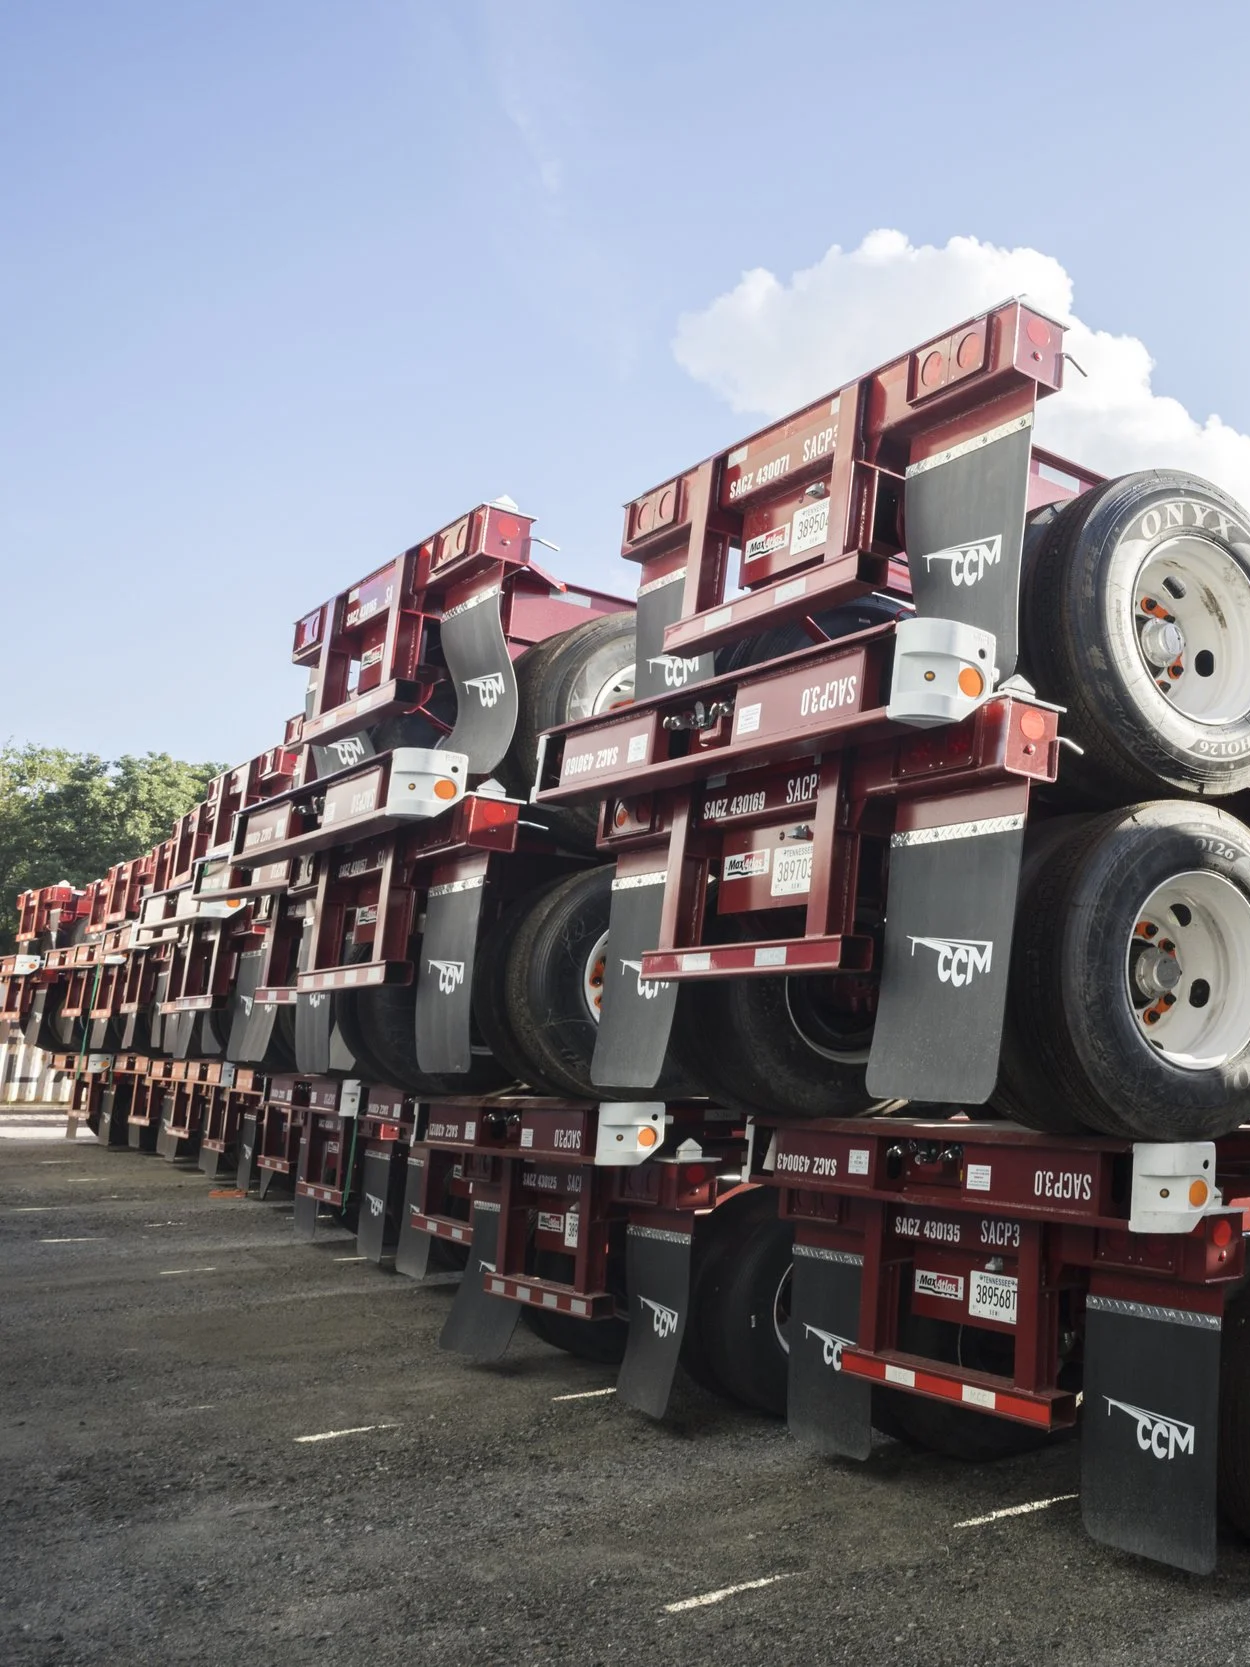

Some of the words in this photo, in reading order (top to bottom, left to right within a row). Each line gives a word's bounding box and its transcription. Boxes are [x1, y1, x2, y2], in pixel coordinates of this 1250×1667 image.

[730, 473, 753, 499] SACZ
[756, 454, 790, 486] 430071
[797, 512, 828, 540] 38950
[1140, 503, 1237, 542] ONYX
[950, 534, 1002, 587] CCM
[801, 675, 857, 716] SACP3.0
[596, 746, 619, 769] SACZ
[786, 774, 820, 804] SACP
[703, 799, 728, 820] SACZ
[730, 791, 766, 815] 430169
[936, 941, 993, 987] CCM
[553, 1129, 582, 1149] SACP3.0
[777, 1153, 810, 1173] 430043
[812, 1157, 836, 1176] SACZ
[1033, 1169, 1092, 1200] SACP3.0
[895, 1217, 921, 1236] SACZ
[924, 1220, 961, 1242] 430135
[983, 1276, 1011, 1287] TENNESSEE
[976, 1284, 1018, 1310] 389568T
[1136, 1418, 1195, 1460] CCM
